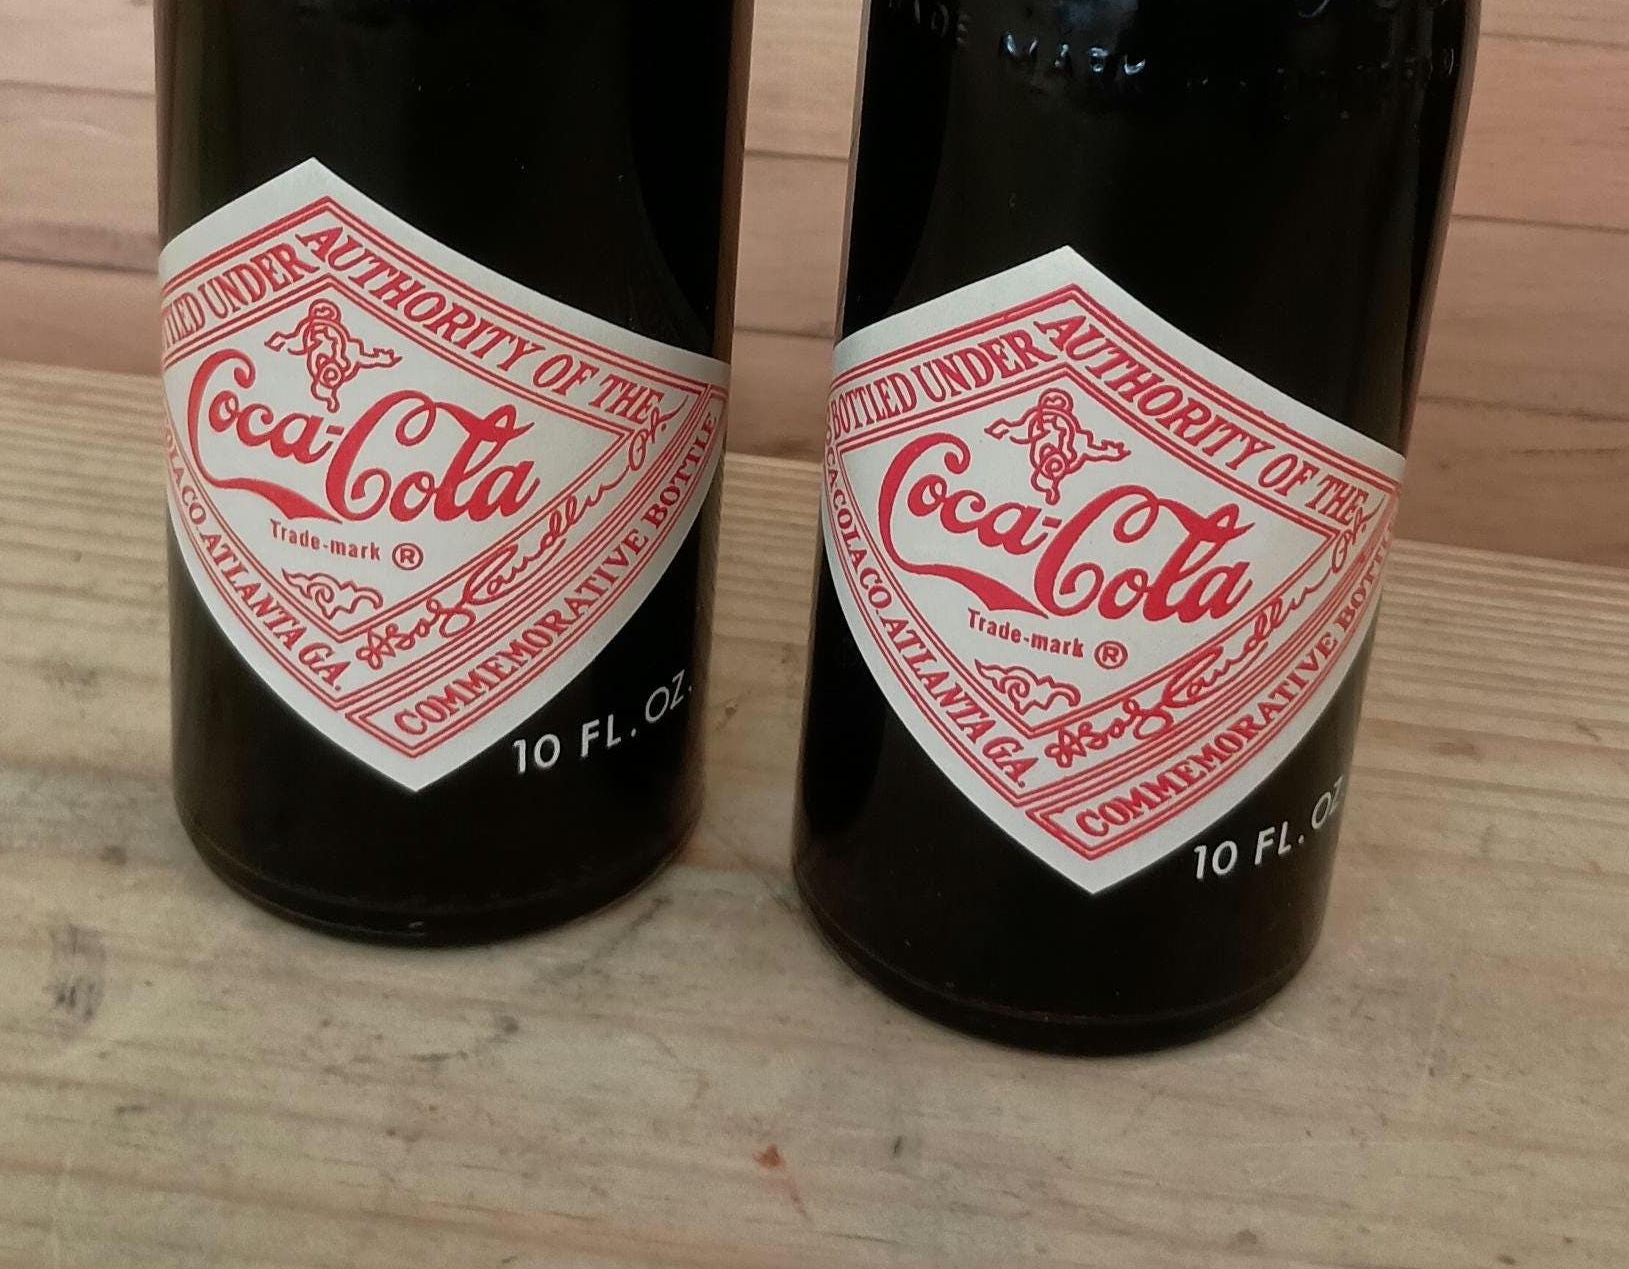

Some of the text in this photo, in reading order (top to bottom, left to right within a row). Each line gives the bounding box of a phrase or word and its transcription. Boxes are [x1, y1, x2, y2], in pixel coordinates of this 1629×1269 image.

[197, 242, 321, 320] UNDER
[295, 226, 546, 372] AUTHORITY
[532, 353, 601, 398] OF
[588, 373, 667, 425] THE
[187, 348, 541, 524] Coca-Cola
[830, 315, 1370, 527] BOTTLED UNDER AUTHORITY OF THE
[200, 531, 309, 652] ATLANTA
[298, 642, 352, 692] GA.
[269, 518, 381, 561] Trade-mark
[394, 410, 719, 735] COMMEMORATIVE BOTTLE
[878, 432, 1256, 624] Coca-Cola
[880, 614, 998, 744] ATLANTA
[981, 735, 1040, 788] GA.
[966, 607, 1085, 659] Trade-mark
[513, 669, 693, 774] 10 FL. OZ.
[1075, 632, 1338, 837] COMMEMORATIVE
[1194, 839, 1239, 879] 10
[1254, 820, 1305, 865] FL.
